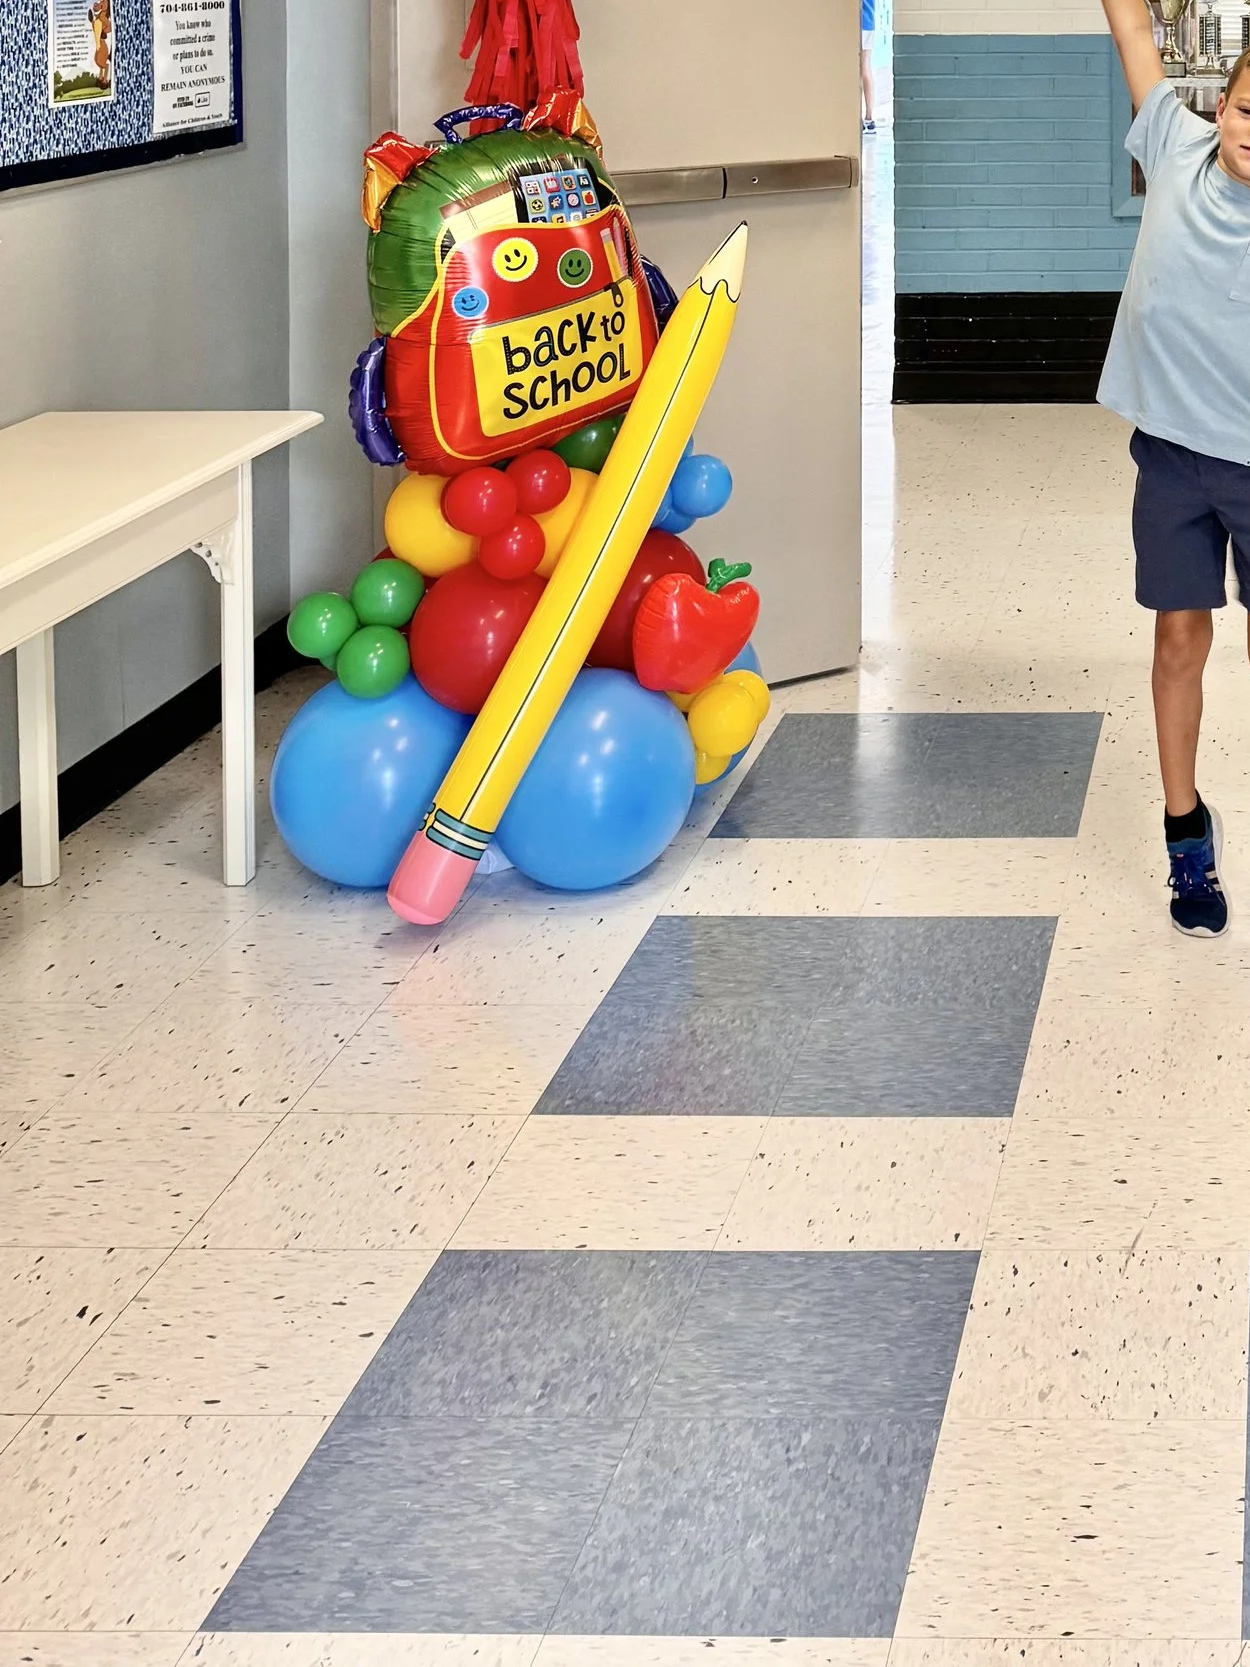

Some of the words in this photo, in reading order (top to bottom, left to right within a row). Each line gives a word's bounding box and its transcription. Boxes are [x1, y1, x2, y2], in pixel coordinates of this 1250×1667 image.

[160, 1, 225, 13] 704-861-8000
[175, 21, 185, 30] You
[187, 20, 200, 29] know
[201, 19, 211, 27] who
[170, 34, 197, 45] committed
[202, 33, 215, 42] crime
[180, 50, 193, 62] plans
[200, 48, 206, 57] do
[181, 66, 193, 74] YOU
[195, 64, 207, 73] CAN
[161, 80, 187, 92] REMAIN
[188, 76, 225, 89] ANONYMOUS
